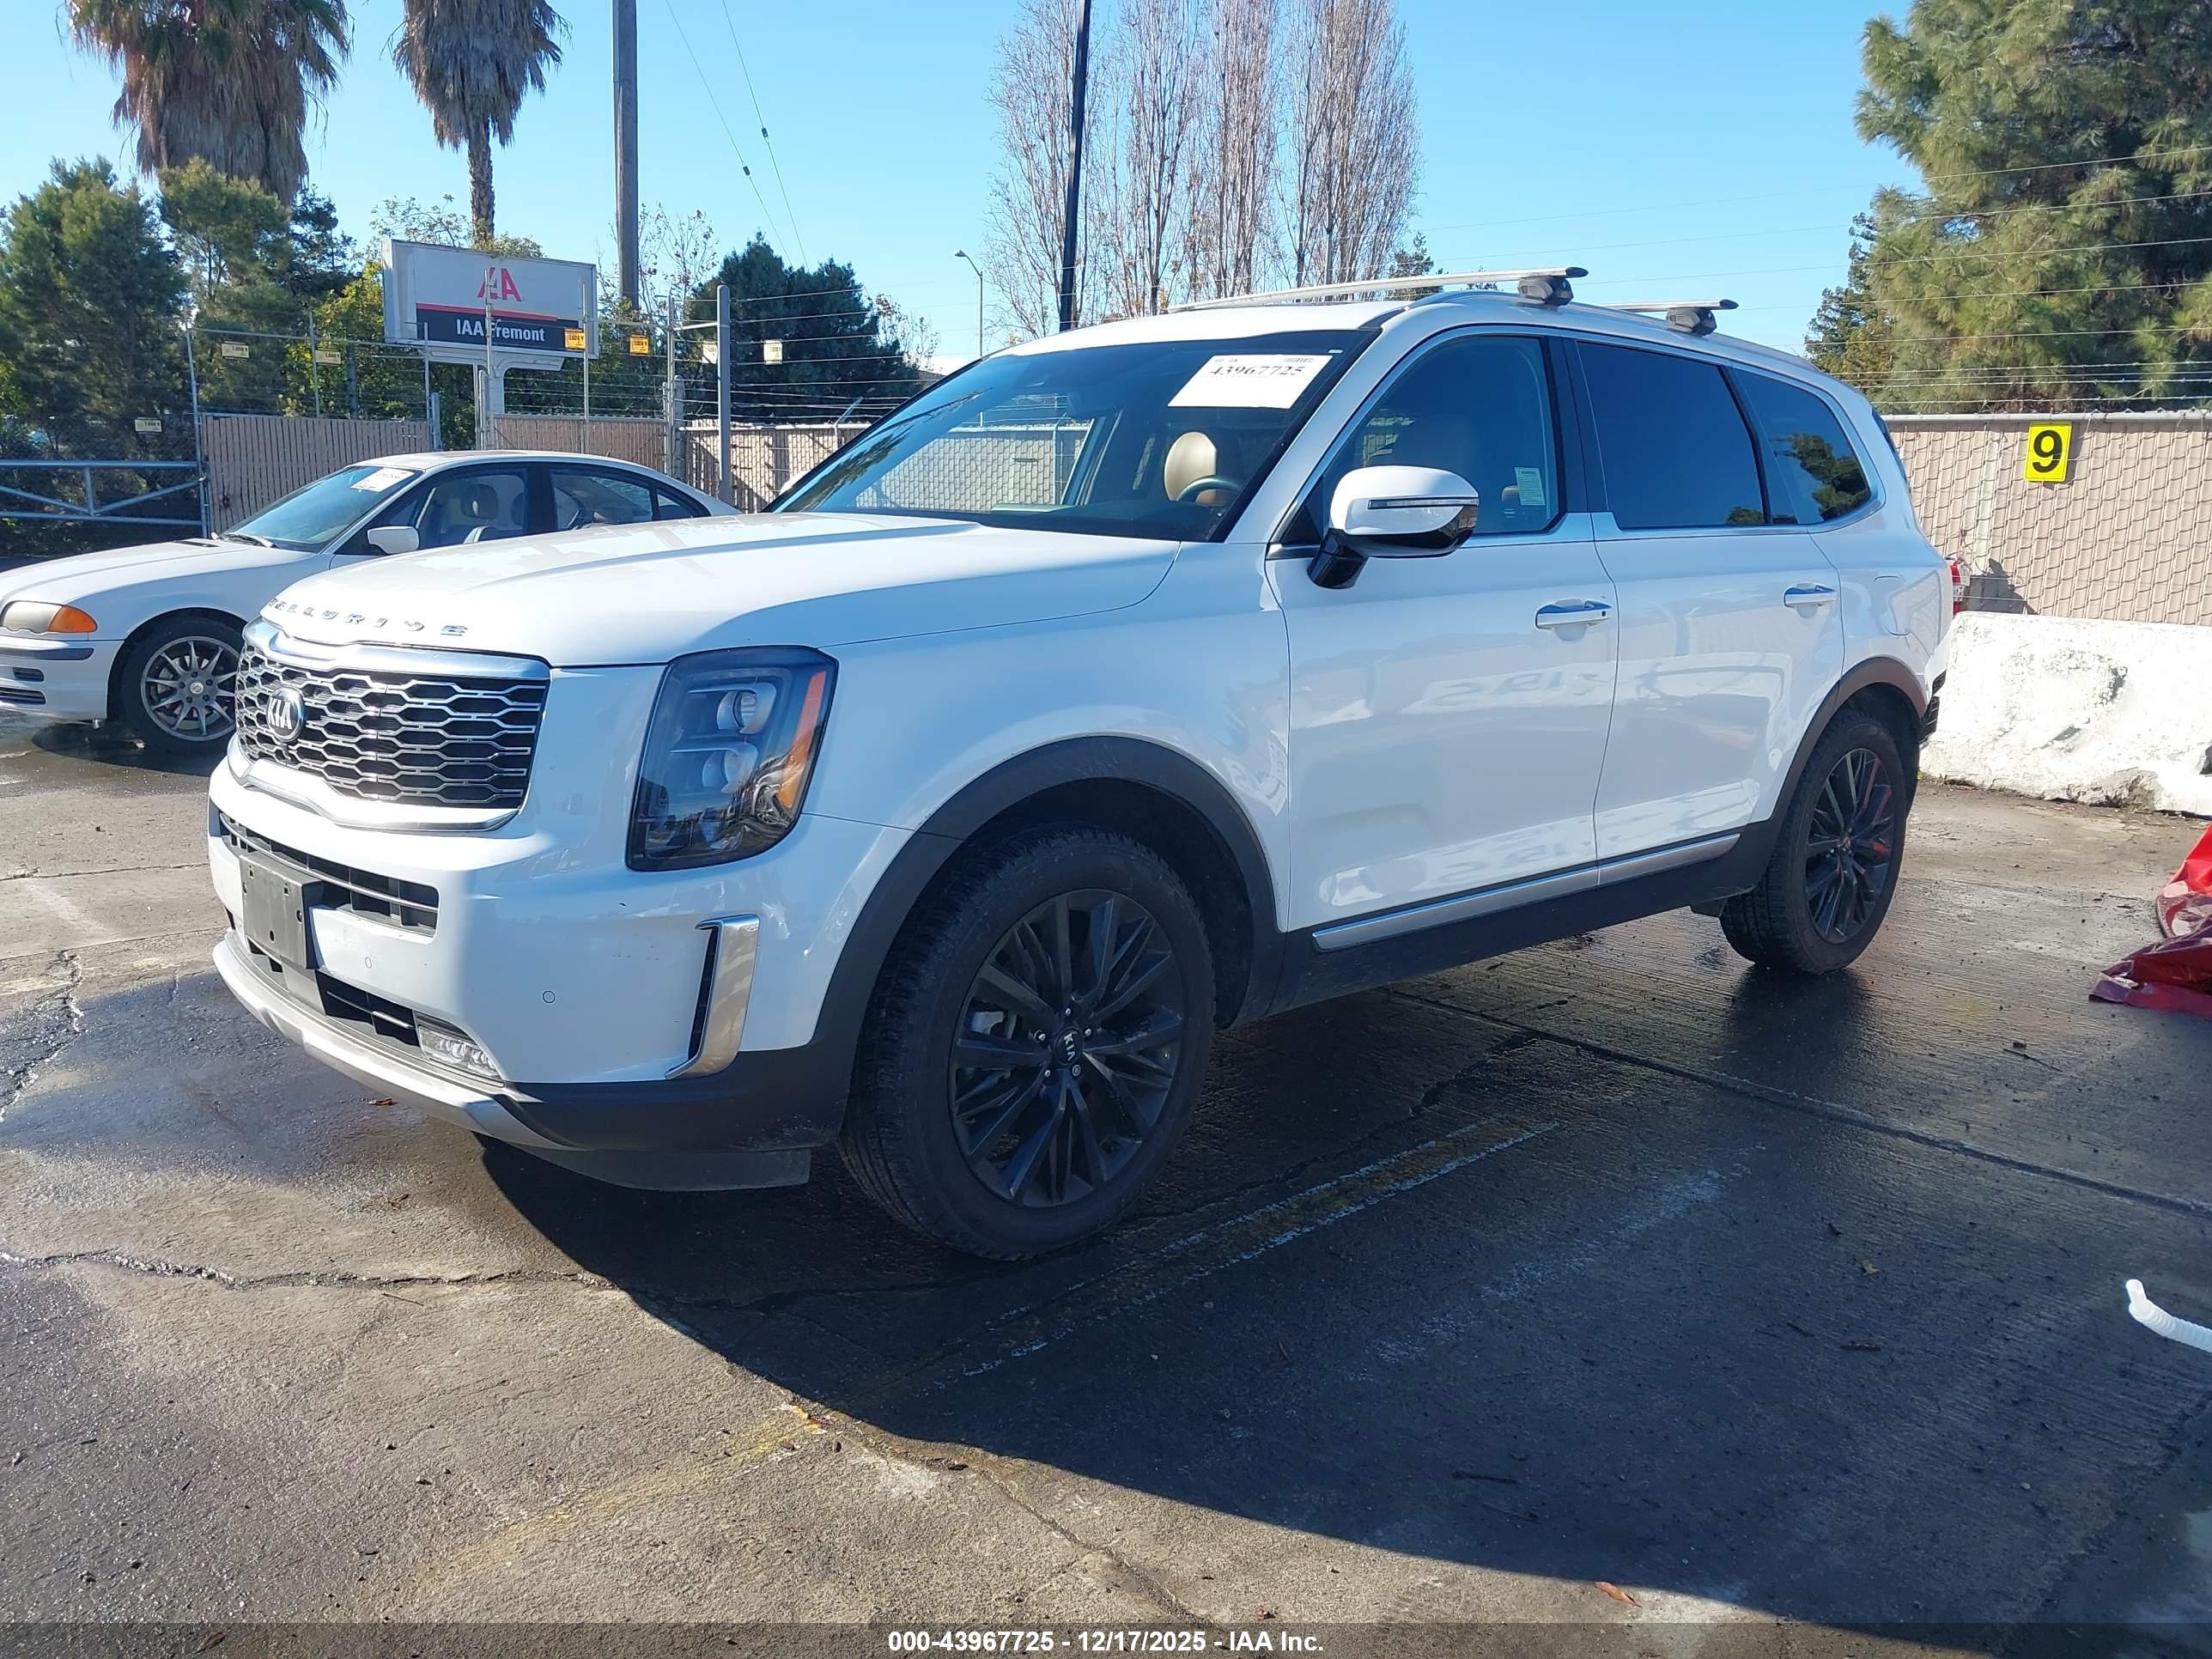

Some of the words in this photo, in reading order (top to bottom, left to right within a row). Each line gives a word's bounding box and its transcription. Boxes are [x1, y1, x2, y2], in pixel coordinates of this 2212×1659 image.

[456, 319, 483, 337] IAA
[2032, 429, 2063, 473] 9
[268, 696, 293, 729] KIA
[1063, 1033, 1076, 1061] KIA
